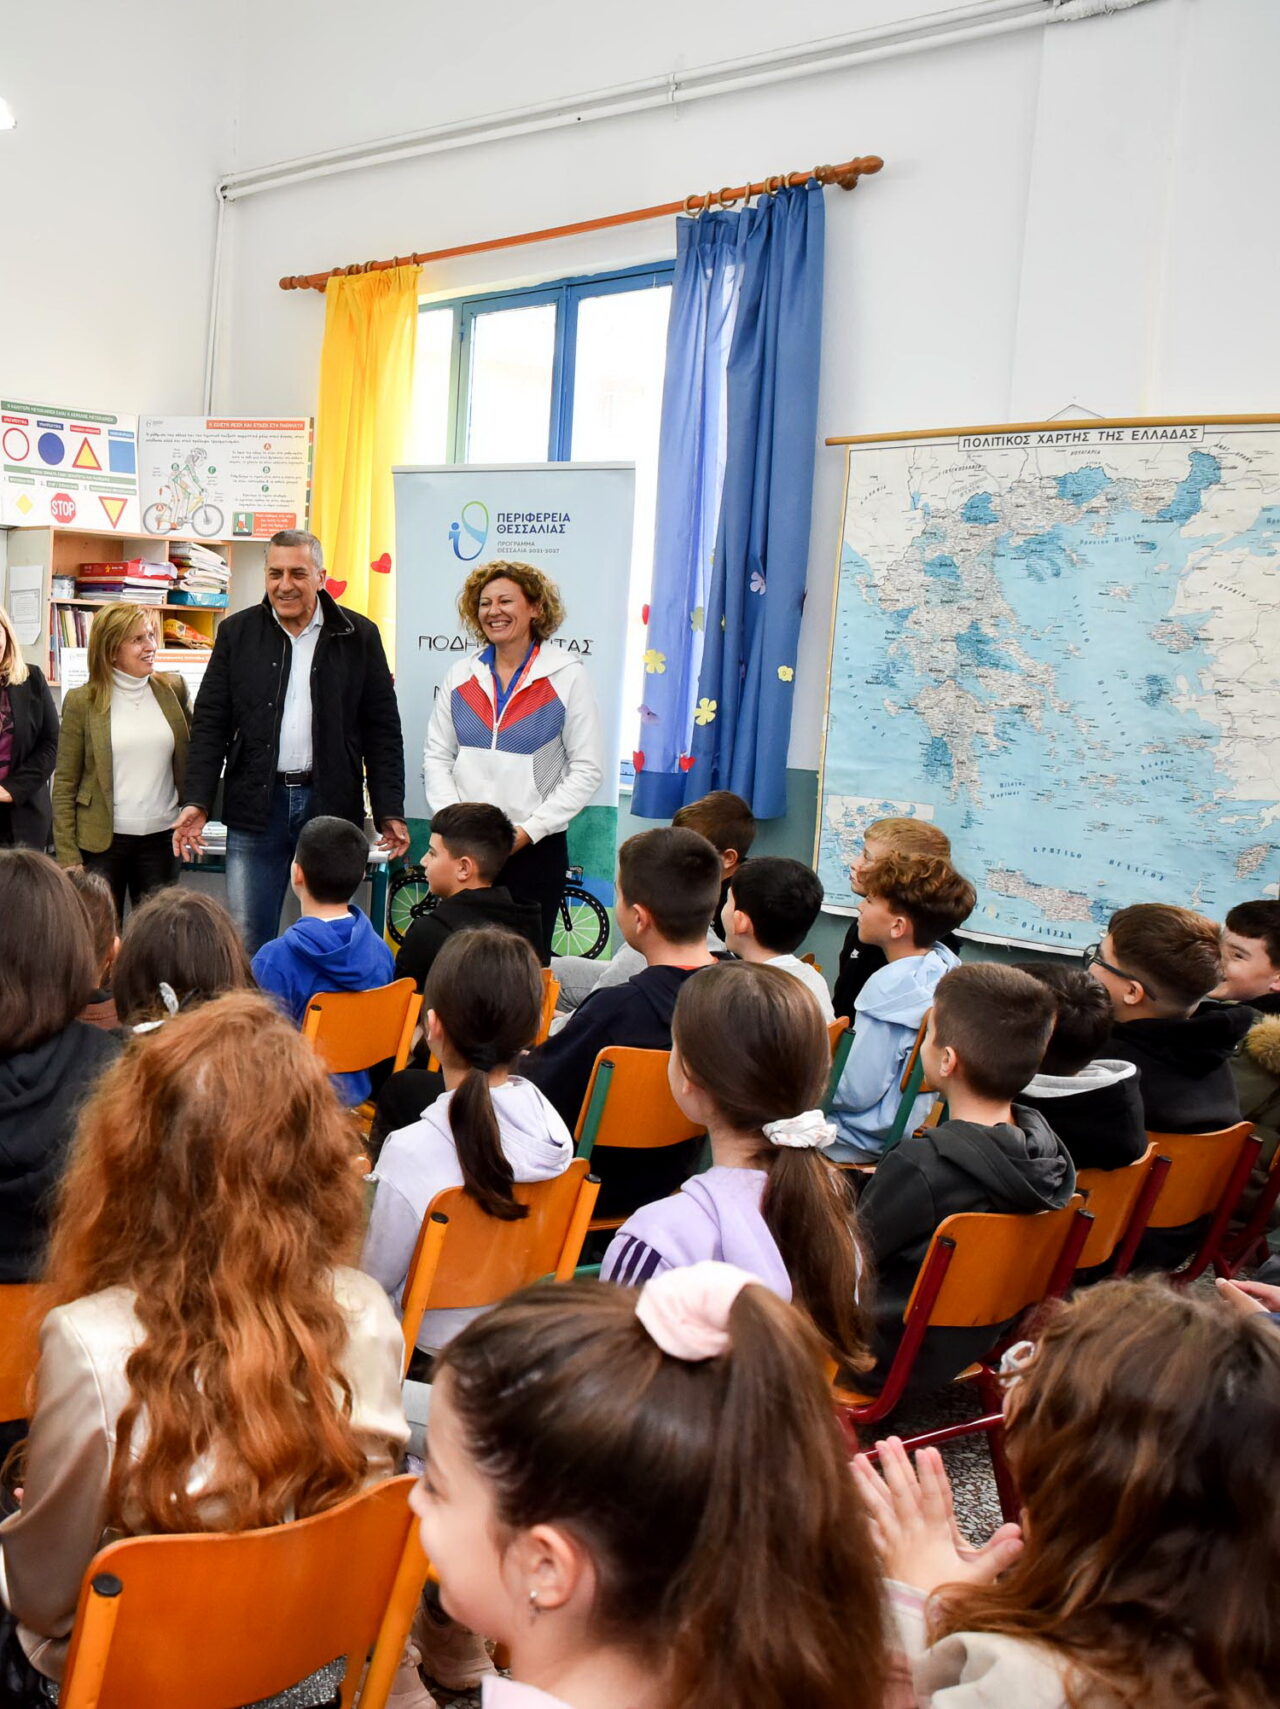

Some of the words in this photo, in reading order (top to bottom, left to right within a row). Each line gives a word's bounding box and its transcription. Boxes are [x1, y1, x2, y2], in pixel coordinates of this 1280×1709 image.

[962, 434, 1030, 448] ΠΟΛΙΤΙΚΟΣ
[1037, 431, 1090, 444] ΧΑΡΤΗΣ
[1098, 430, 1124, 441] ΤΗΣ
[1131, 428, 1198, 441] ΕΛΛΑΔΑΣ
[51, 500, 75, 516] STOP
[497, 512, 571, 523] ΠΕΡΙΦΕΡΕΙΑ
[497, 524, 566, 534] ΘΕΣΣΑΛΙΑΣ
